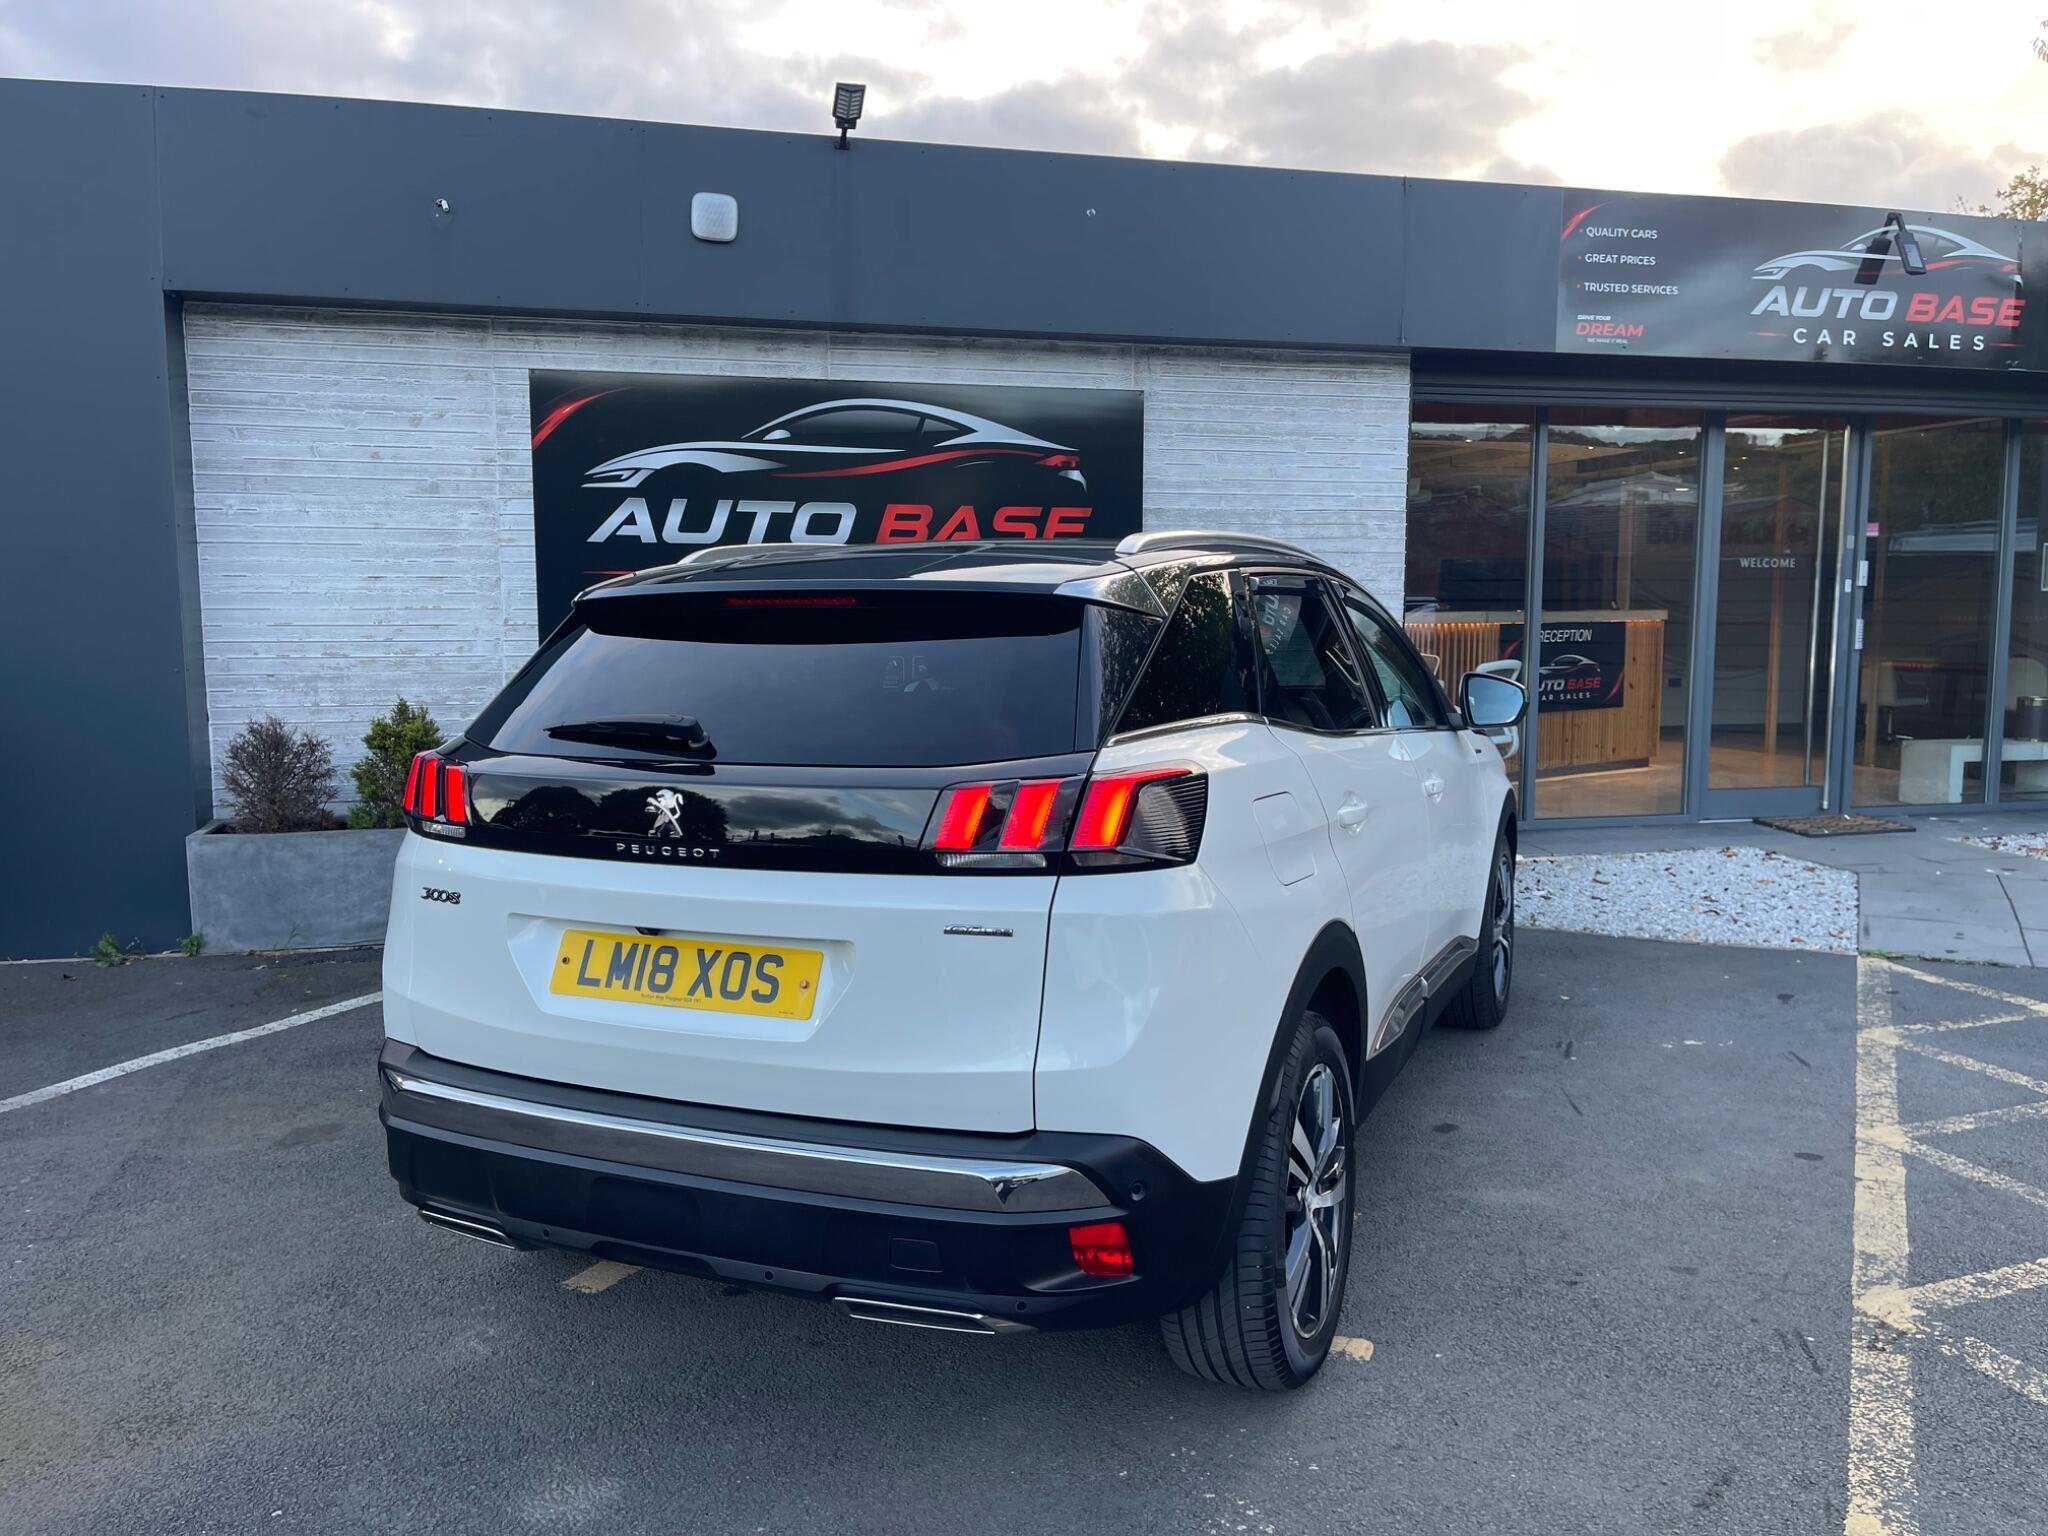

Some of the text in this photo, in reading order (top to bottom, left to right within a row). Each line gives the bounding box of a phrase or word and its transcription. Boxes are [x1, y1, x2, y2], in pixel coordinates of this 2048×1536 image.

[1586, 226, 1658, 239] QUALITY CARS
[1585, 253, 1656, 266] GREAT PRICES
[1584, 282, 1679, 295] TRUSTED SERVICES
[1750, 285, 2026, 327] AUTO BASE
[1576, 322, 1644, 337] DREAM
[1793, 328, 1985, 351] CAR SALES
[586, 497, 1093, 545] AUTO BASE
[1739, 557, 1796, 568] WELCOME
[1568, 677, 1600, 690] BASE
[616, 843, 720, 858] PEUGEOT
[421, 887, 461, 904] 3008
[576, 939, 784, 1004] LM18 XOS
